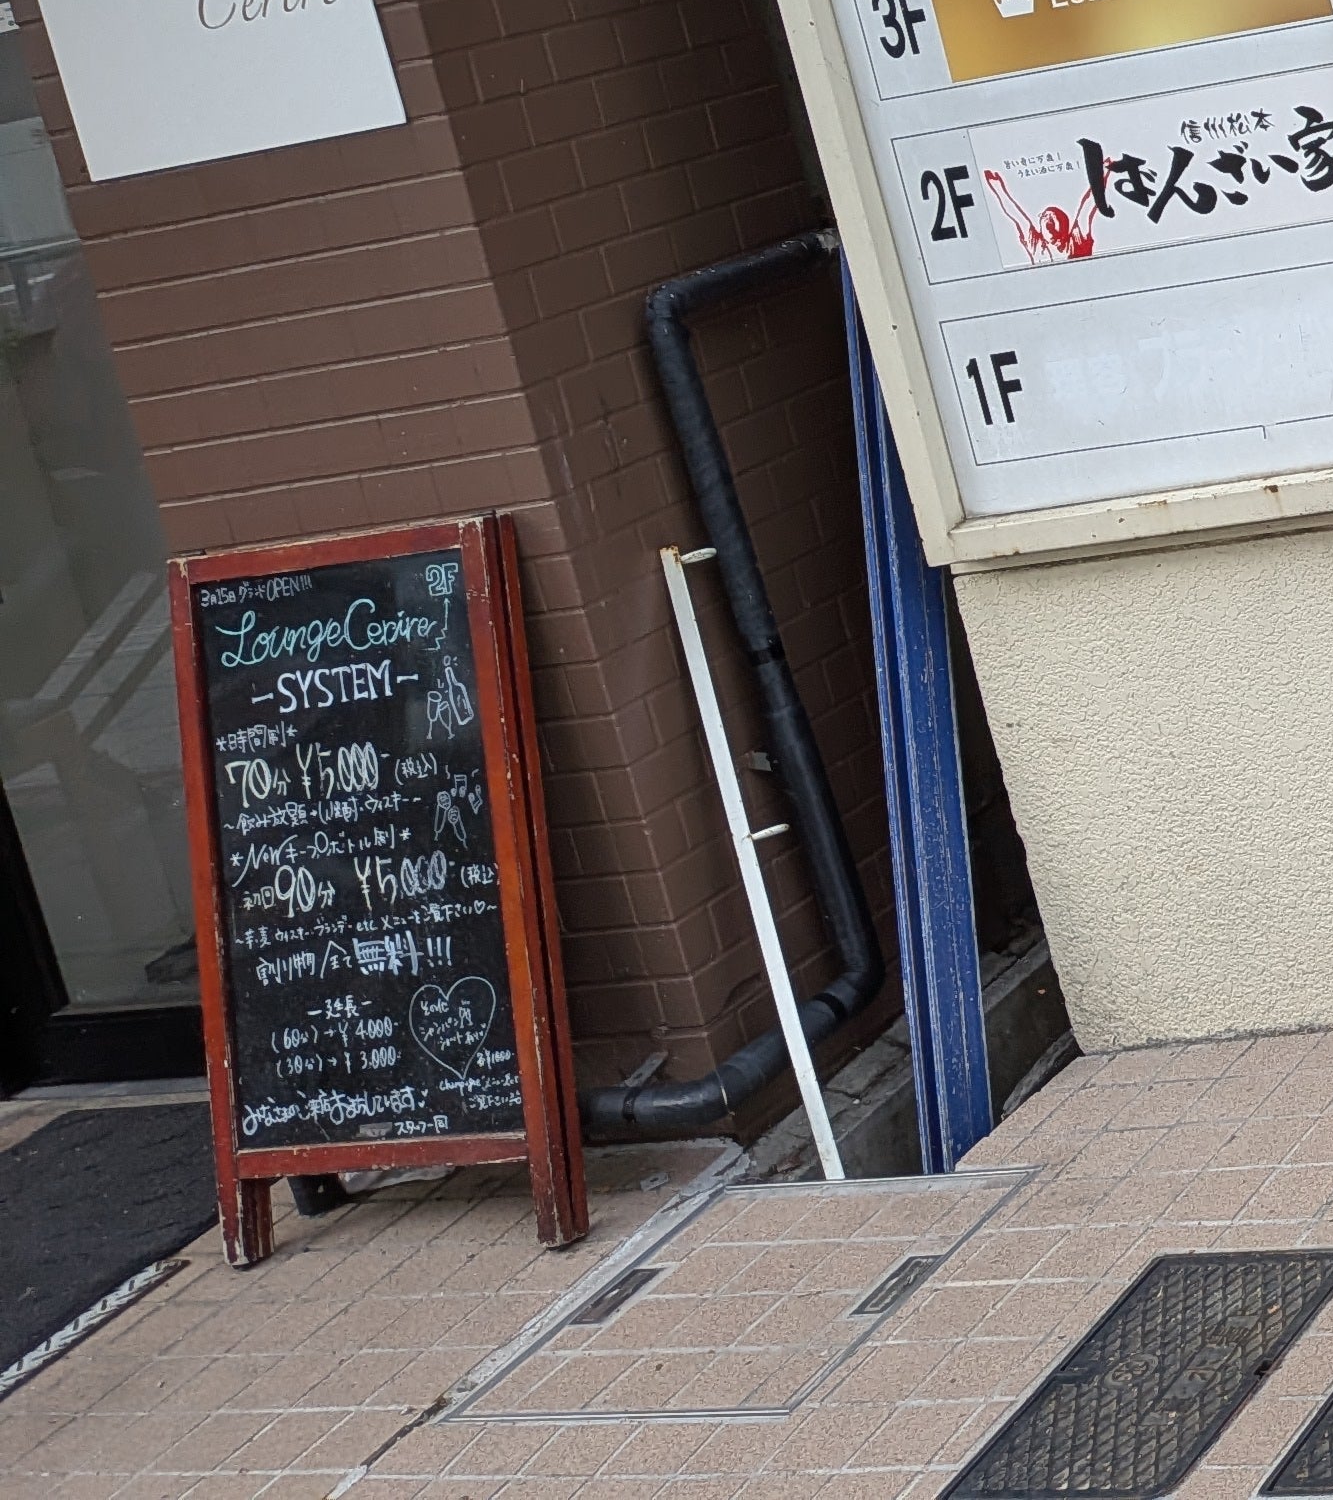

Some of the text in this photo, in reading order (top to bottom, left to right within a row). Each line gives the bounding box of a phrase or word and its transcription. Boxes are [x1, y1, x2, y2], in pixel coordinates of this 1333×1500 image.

[1180, 108, 1277, 144] 信州松本
[921, 165, 977, 242] 2F
[967, 351, 1023, 426] 1F
[426, 562, 459, 597] 2F
